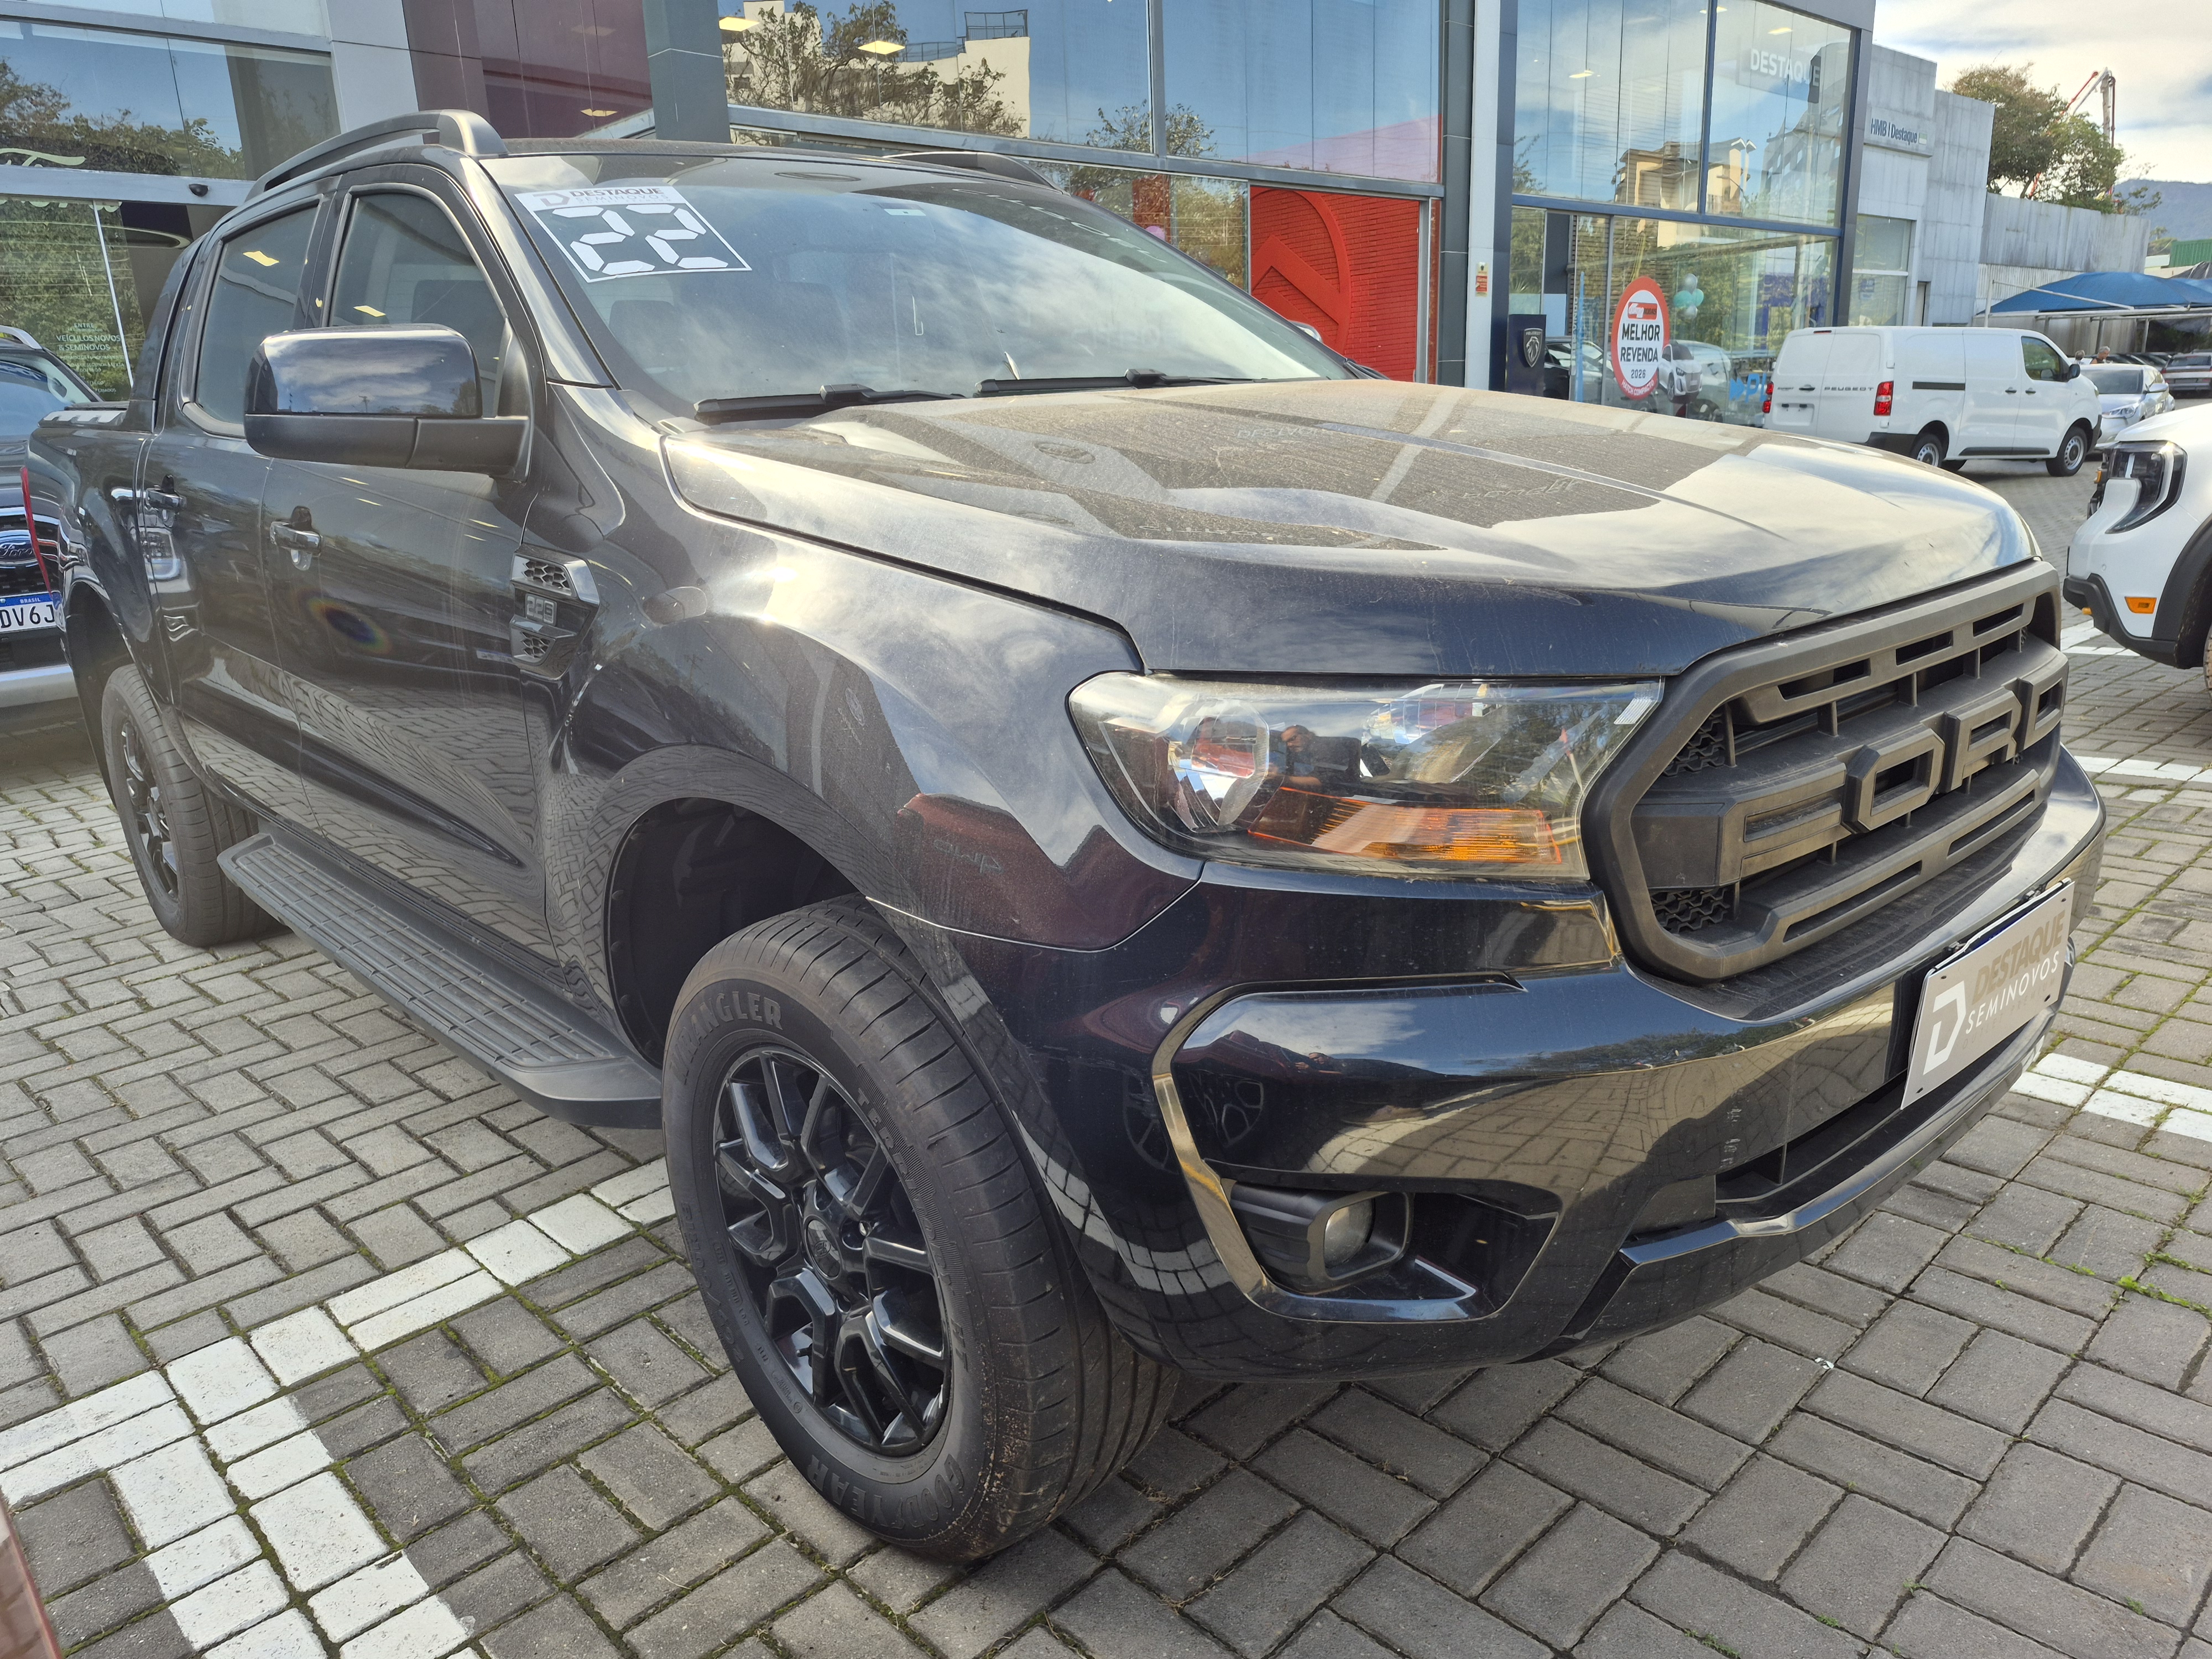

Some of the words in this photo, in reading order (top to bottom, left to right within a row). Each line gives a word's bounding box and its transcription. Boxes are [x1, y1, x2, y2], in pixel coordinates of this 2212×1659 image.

[1750, 49, 1820, 86] DESTAQUE
[1870, 118, 1886, 137] HMB
[1891, 124, 1918, 144] Destaque
[570, 188, 662, 197] DESTAQUE
[552, 204, 728, 275] 22
[1622, 323, 1660, 341] MELHOR
[1620, 347, 1658, 362] REVENDA
[1621, 379, 1634, 395] HATCH
[1634, 379, 1654, 396] COMPACTO
[1631, 369, 1646, 378] 2026
[1720, 658, 2067, 887] FORD
[1971, 910, 2066, 1006] DESTAQUE
[1965, 950, 2059, 1035] SEMINOVOS
[669, 991, 783, 1086] WRANGLER
[807, 1453, 964, 1530] GOODYEAR
